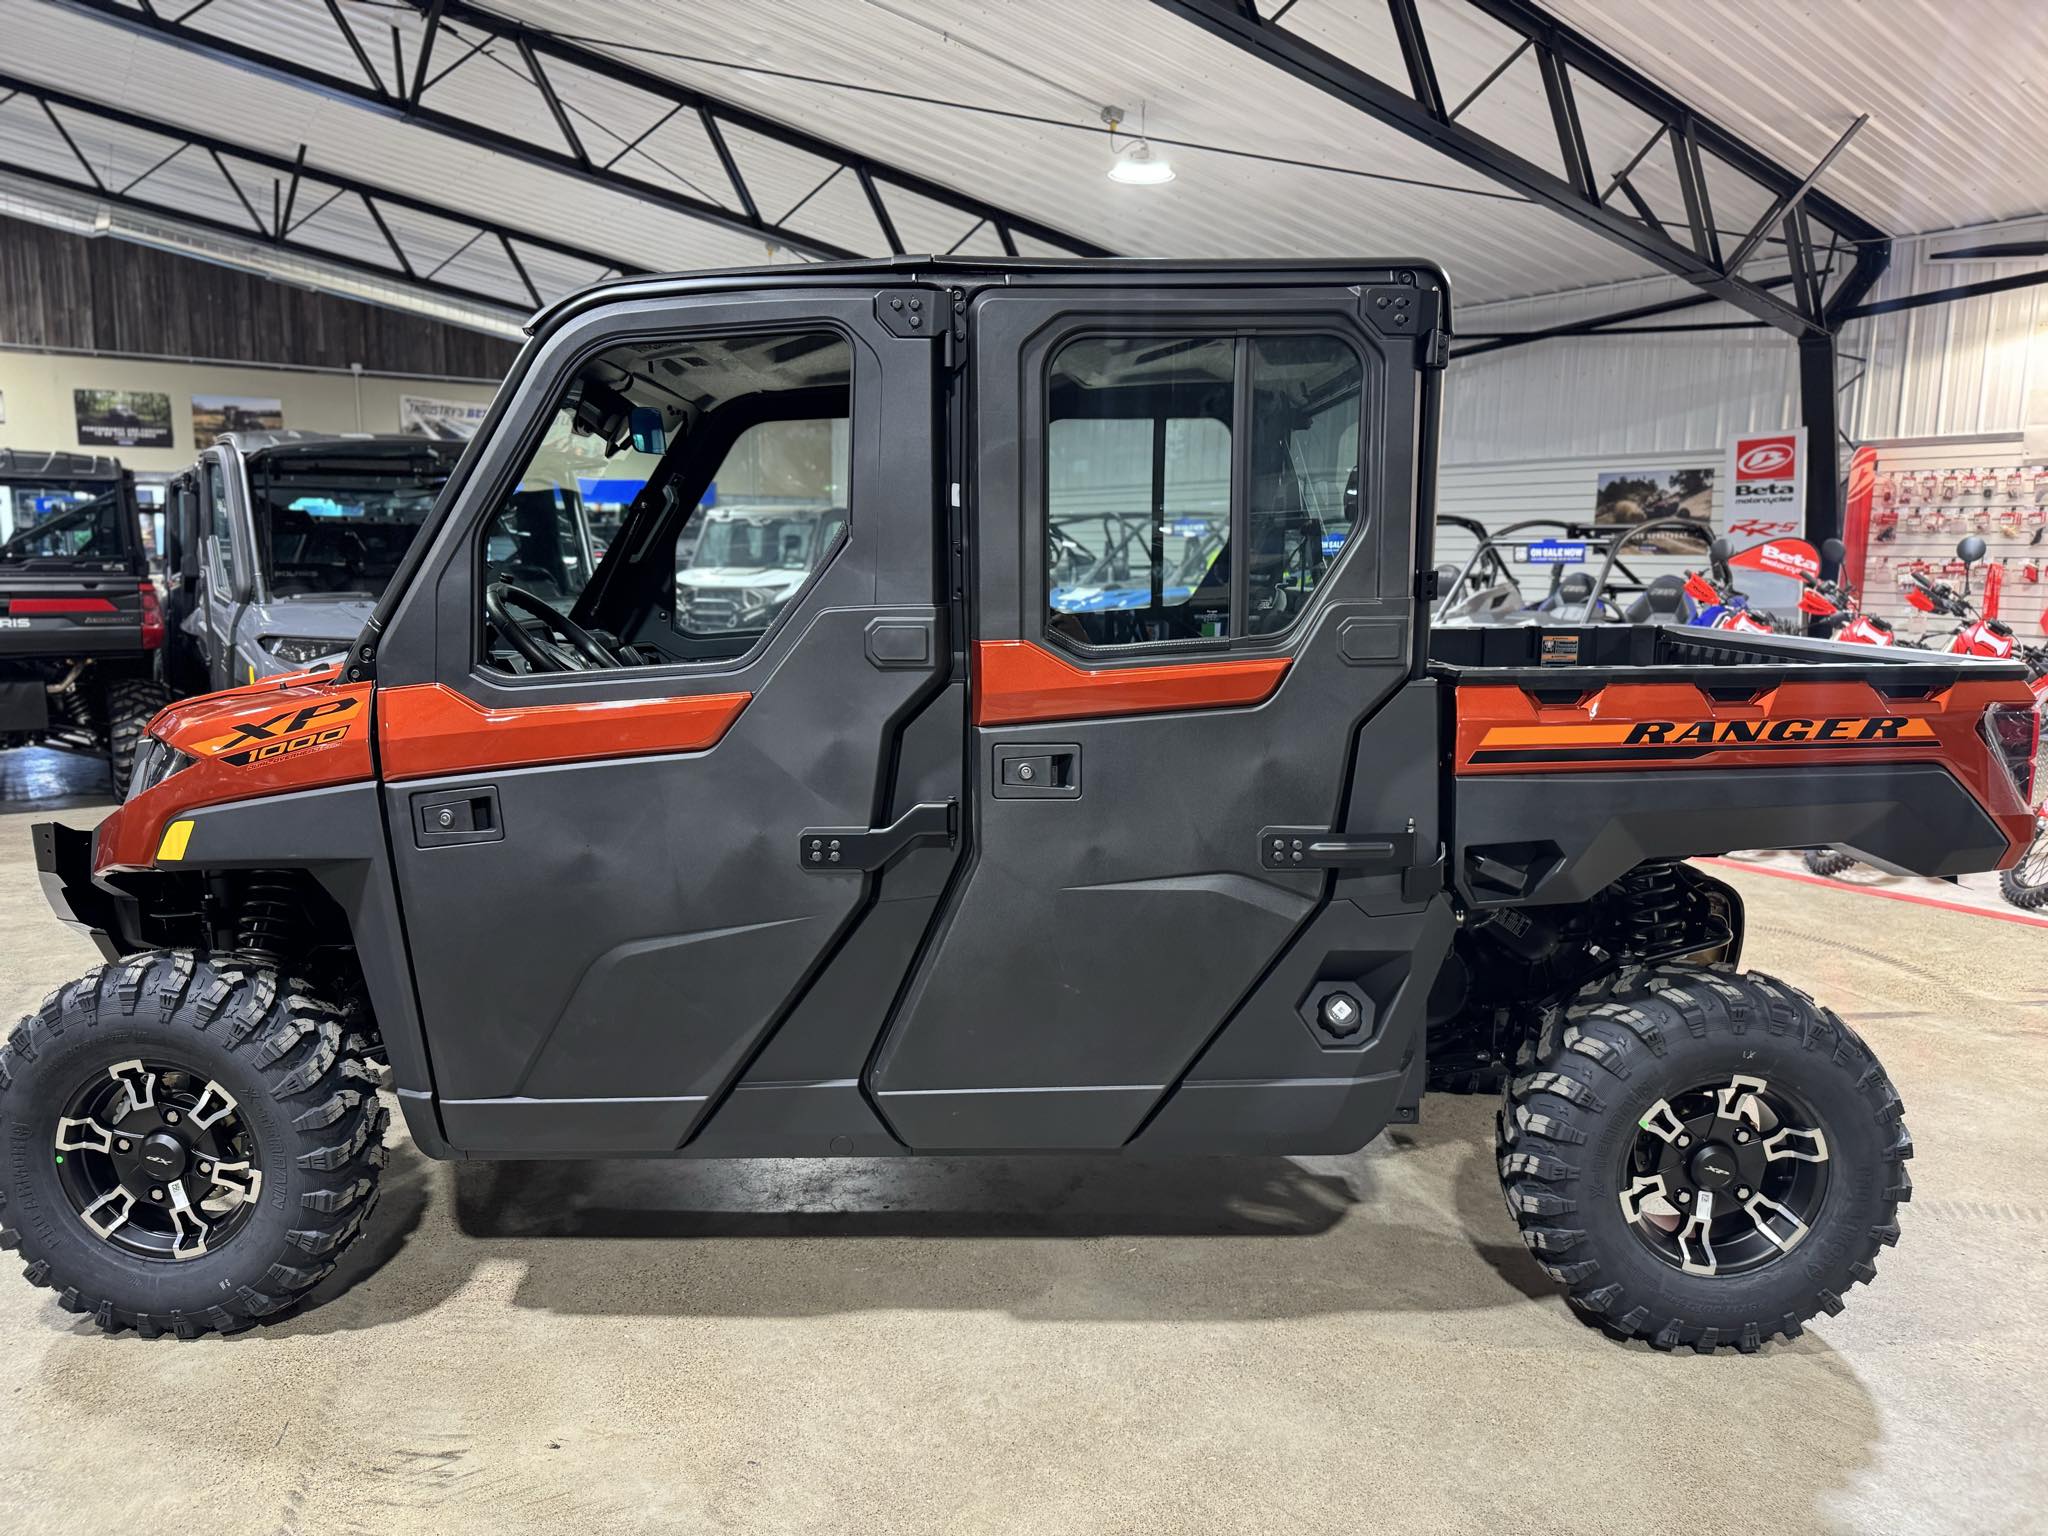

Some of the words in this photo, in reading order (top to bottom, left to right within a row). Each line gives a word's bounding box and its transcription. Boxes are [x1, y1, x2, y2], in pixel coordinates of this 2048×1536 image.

[1734, 495, 1794, 505] motorcycles
[1735, 484, 1795, 497] Beta
[1530, 548, 1542, 557] ON
[1543, 548, 1563, 557] SALE
[1564, 548, 1584, 557] NOW
[1760, 543, 1818, 571] Beta
[214, 697, 358, 752] XP
[1622, 716, 1909, 745] RANGER
[247, 724, 351, 763] 1000
